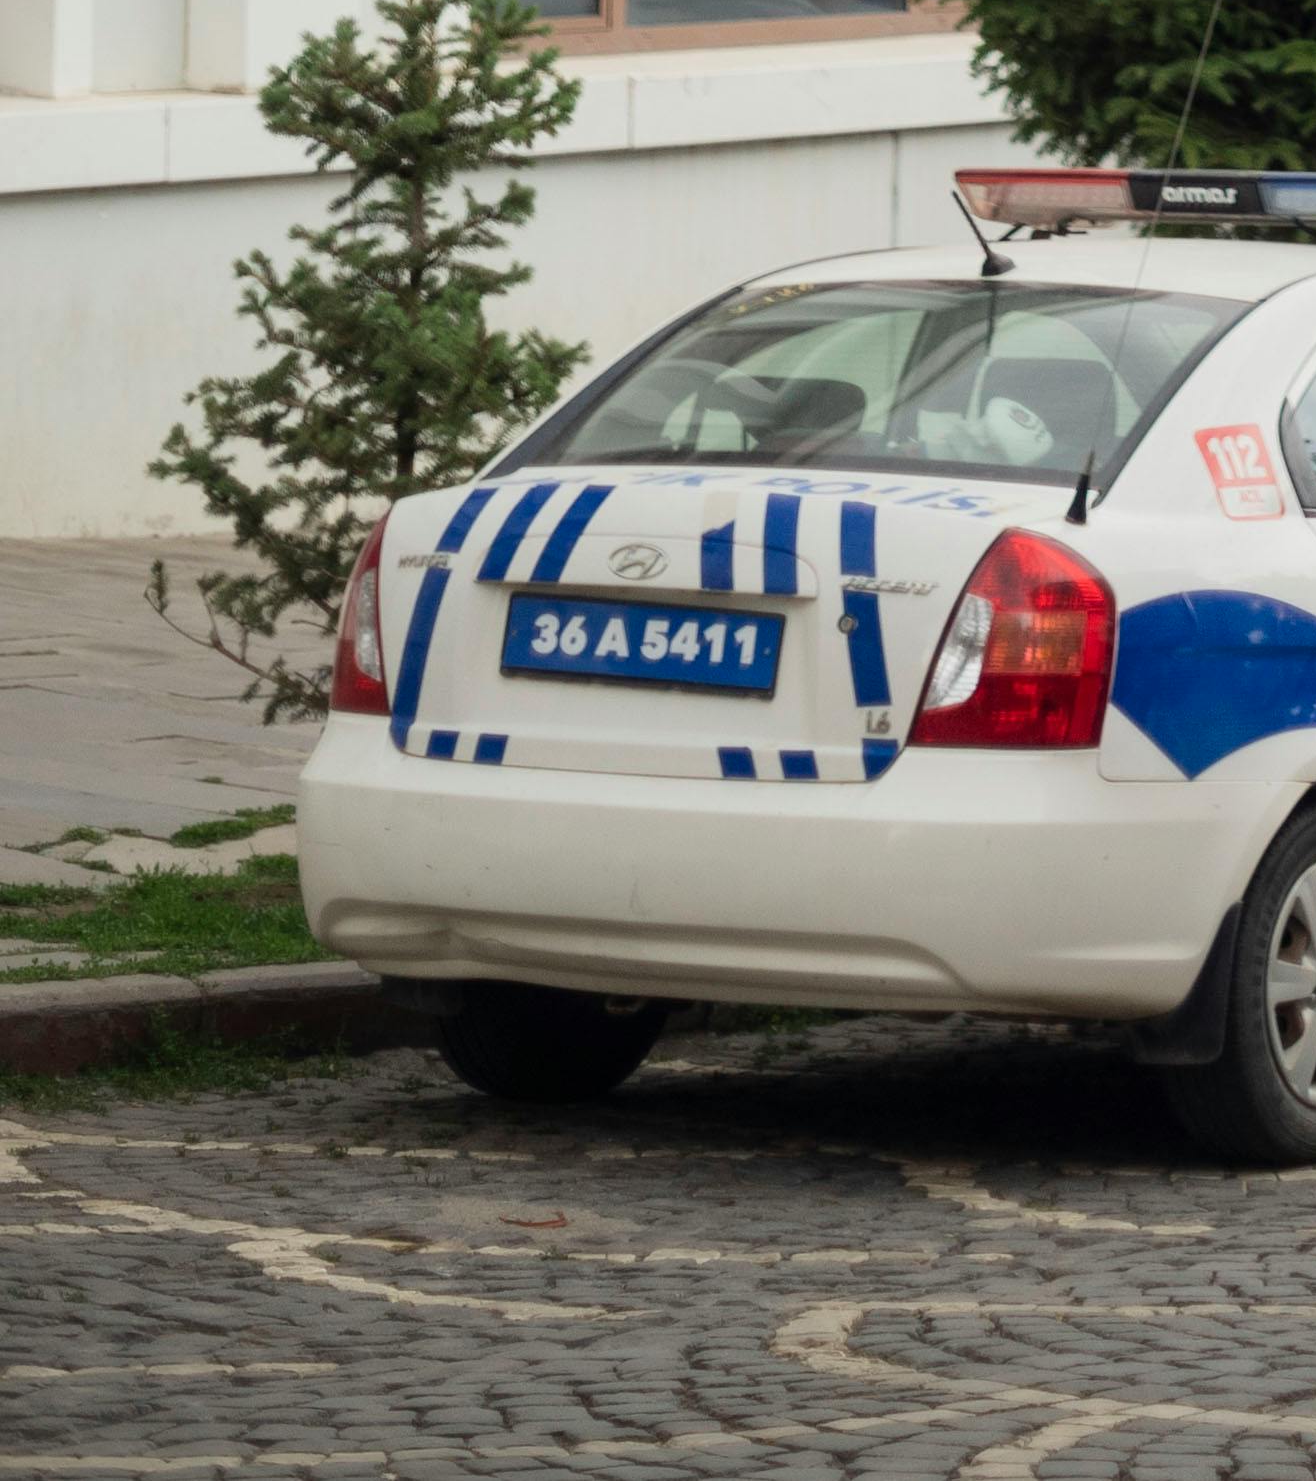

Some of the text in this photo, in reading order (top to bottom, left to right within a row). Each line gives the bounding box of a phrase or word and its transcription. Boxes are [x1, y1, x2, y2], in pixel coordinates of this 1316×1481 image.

[1206, 434, 1268, 480] 112
[531, 613, 758, 666] 36 A 5411
